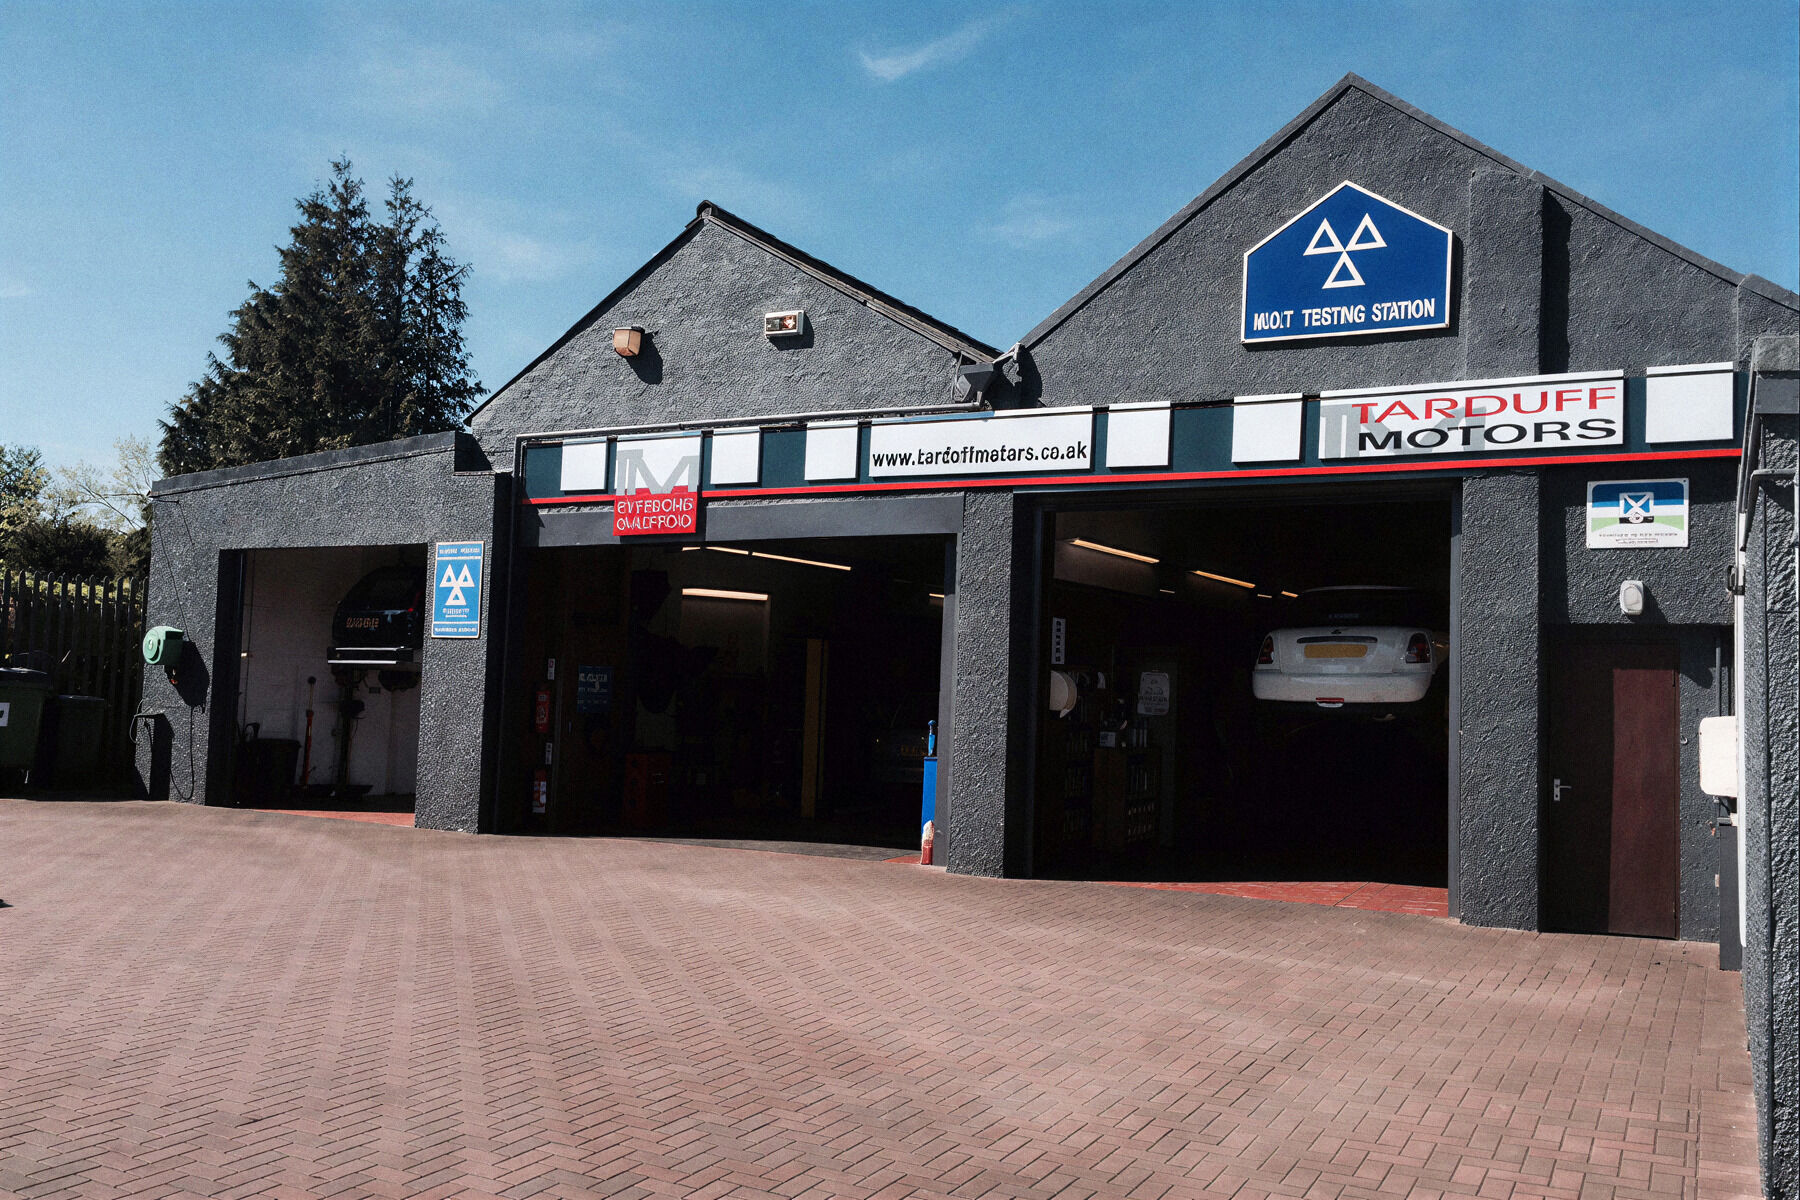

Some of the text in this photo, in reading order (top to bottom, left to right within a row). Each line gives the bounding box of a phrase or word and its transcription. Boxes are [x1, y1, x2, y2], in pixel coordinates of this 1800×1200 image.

[1371, 298, 1436, 322] STATION
[1351, 386, 1617, 424] TARDUFF
[1358, 418, 1617, 451] MOTORS
